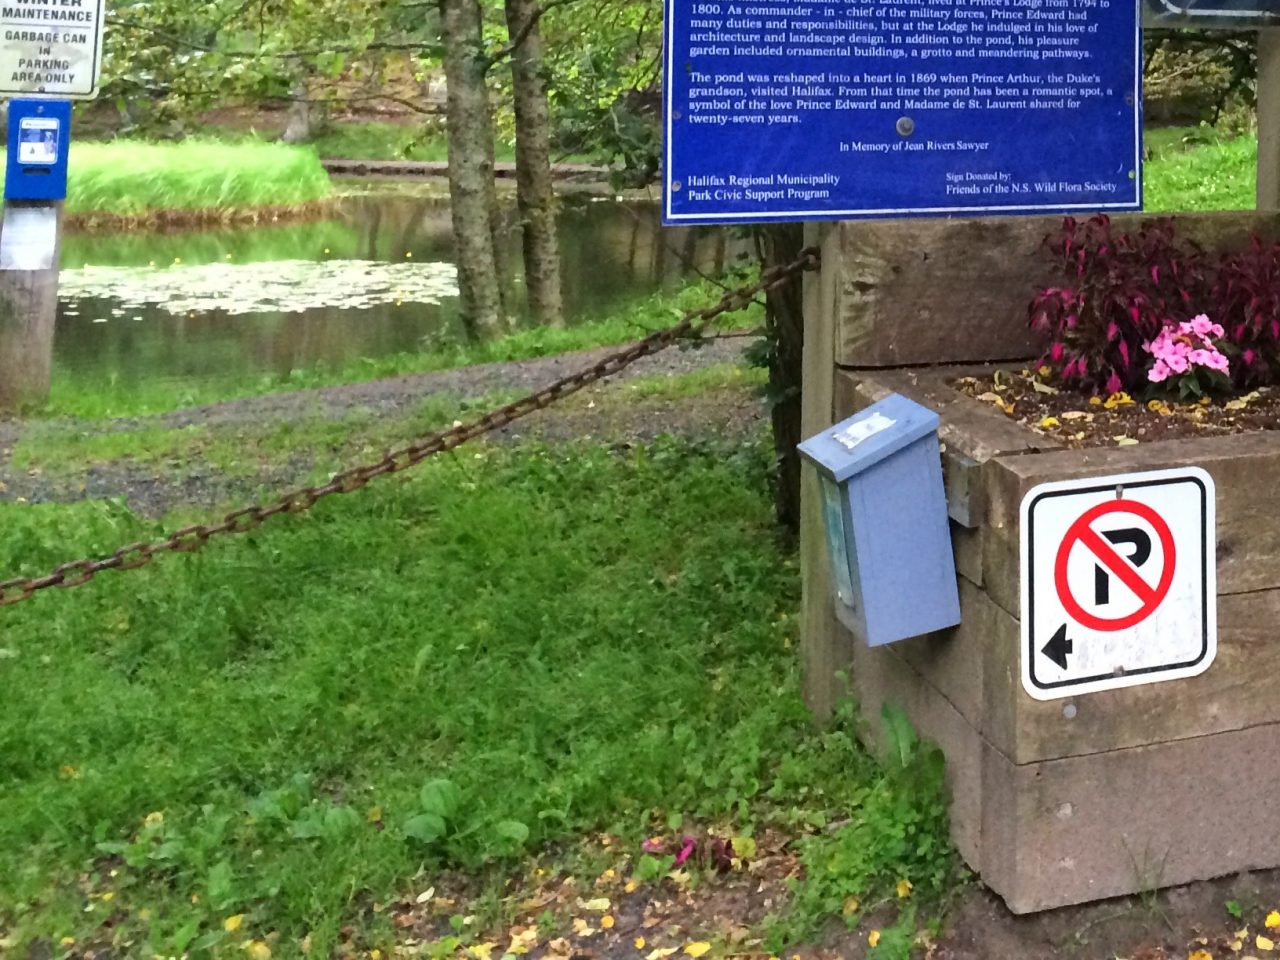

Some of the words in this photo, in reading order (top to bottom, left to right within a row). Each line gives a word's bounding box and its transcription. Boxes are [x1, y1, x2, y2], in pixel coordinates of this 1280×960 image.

[2, 7, 93, 22] MAINTENANCE
[5, 30, 60, 43] GARBAGE
[63, 33, 87, 44] CAN
[39, 46, 51, 55] IN
[689, 44, 729, 58] garden
[733, 45, 782, 56] included
[786, 45, 850, 56] ornamental
[854, 46, 907, 60] buildings,
[911, 49, 917, 57] a
[920, 46, 952, 60] grotto
[955, 47, 975, 57] and
[978, 47, 1039, 60] meandering
[1041, 47, 1093, 60] pathways.
[18, 58, 70, 70] PARKING
[11, 72, 42, 82] AREA
[45, 73, 75, 83] ONLY
[690, 72, 711, 82] The
[714, 72, 743, 85] pond
[773, 72, 824, 85] reshaped
[828, 72, 850, 83] into
[853, 75, 860, 83] a
[863, 72, 892, 83] heart
[895, 72, 906, 83] in
[911, 72, 936, 83] 1869
[940, 72, 968, 83] when
[971, 72, 1003, 83] Prince
[1006, 72, 1043, 85] Arthur,
[1047, 72, 1063, 83] the
[1066, 72, 1100, 83] Duke's
[688, 98, 730, 112] symbol
[734, 98, 746, 109] of
[748, 98, 766, 109] the
[770, 98, 792, 109] love
[796, 98, 831, 109] Prince
[834, 98, 876, 109] Edward
[880, 98, 900, 109] and
[904, 98, 949, 109] Madame
[952, 98, 965, 109] de
[968, 98, 982, 108] St.
[986, 98, 1026, 108] Laurent
[1029, 98, 1064, 108] shared
[1067, 98, 1080, 108] for
[688, 112, 764, 126] twenty-seven
[767, 115, 801, 126] years.
[839, 140, 849, 151] In
[851, 140, 890, 154] Memory
[892, 140, 902, 151] of
[904, 140, 924, 151] Jean
[926, 140, 955, 150] Rivers
[956, 140, 988, 153] Sawyer
[687, 174, 725, 185] Halifax
[728, 174, 773, 188] Regional
[776, 173, 839, 187] Municipality
[945, 170, 964, 184] Sign
[965, 170, 997, 181] Donated
[998, 170, 1010, 183] by:
[946, 182, 980, 194] Friends
[982, 182, 993, 193] of
[994, 182, 1009, 193] the
[1011, 182, 1031, 193] N.S.
[1034, 181, 1056, 192] Wild
[1058, 181, 1082, 192] Flora
[1084, 180, 1116, 194] Society
[688, 189, 711, 200] Park
[714, 188, 742, 199] Civic
[744, 188, 784, 202] Support
[787, 188, 829, 201] Program
